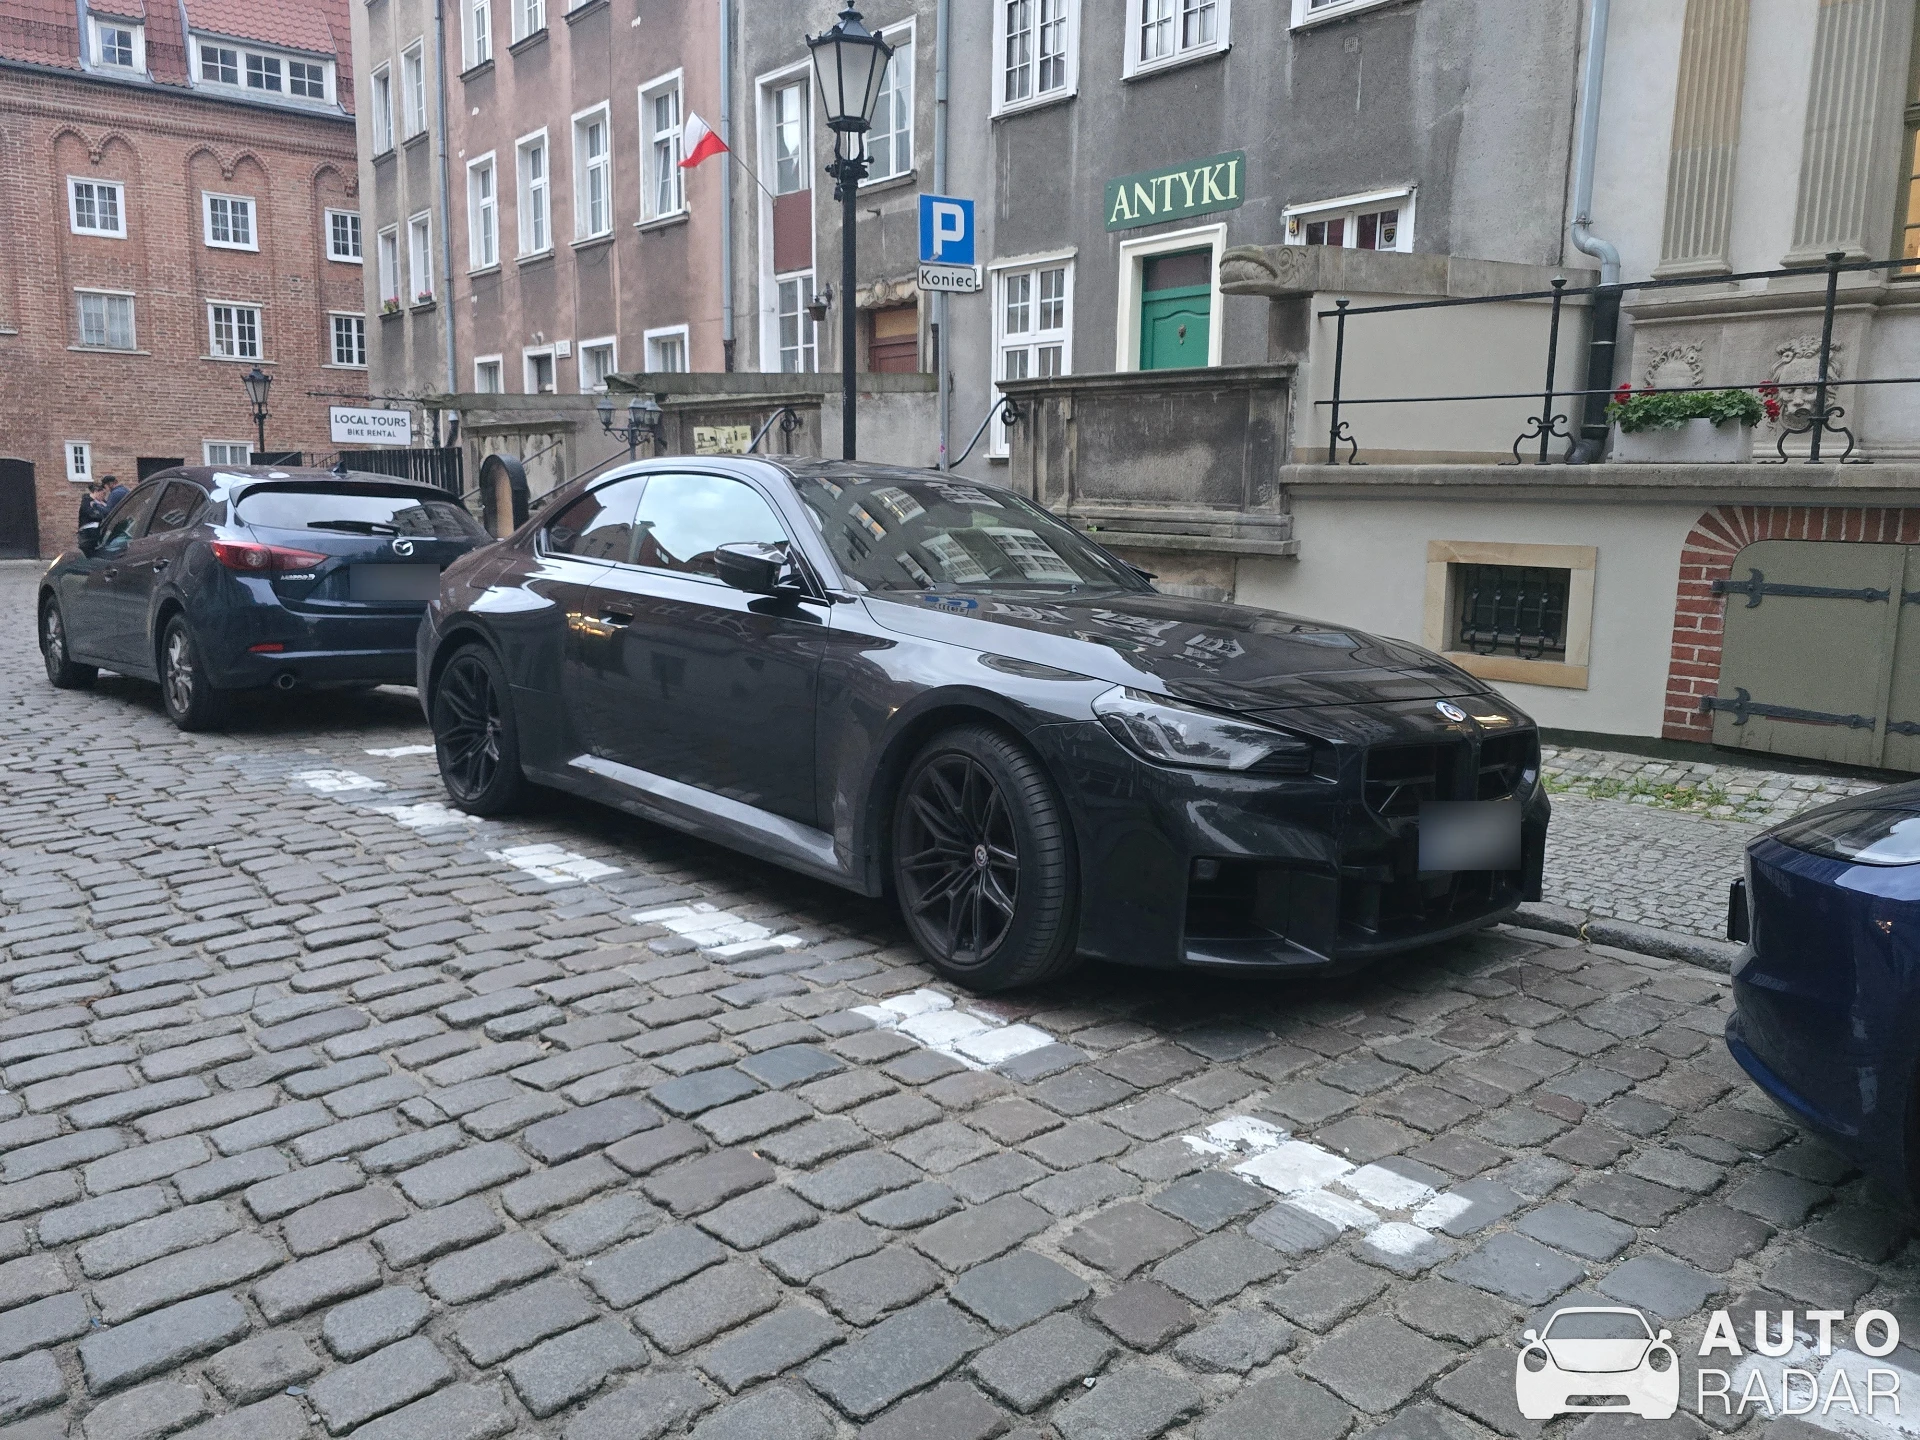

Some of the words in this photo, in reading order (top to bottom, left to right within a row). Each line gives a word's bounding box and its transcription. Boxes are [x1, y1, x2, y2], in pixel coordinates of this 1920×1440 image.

[1109, 160, 1239, 223] ANTYKI
[932, 201, 965, 256] P
[921, 269, 973, 288] Koniec
[334, 414, 369, 425] LOCAL
[371, 416, 407, 427] TOURS
[347, 428, 364, 436] BIKE
[367, 429, 397, 438] RENTAL
